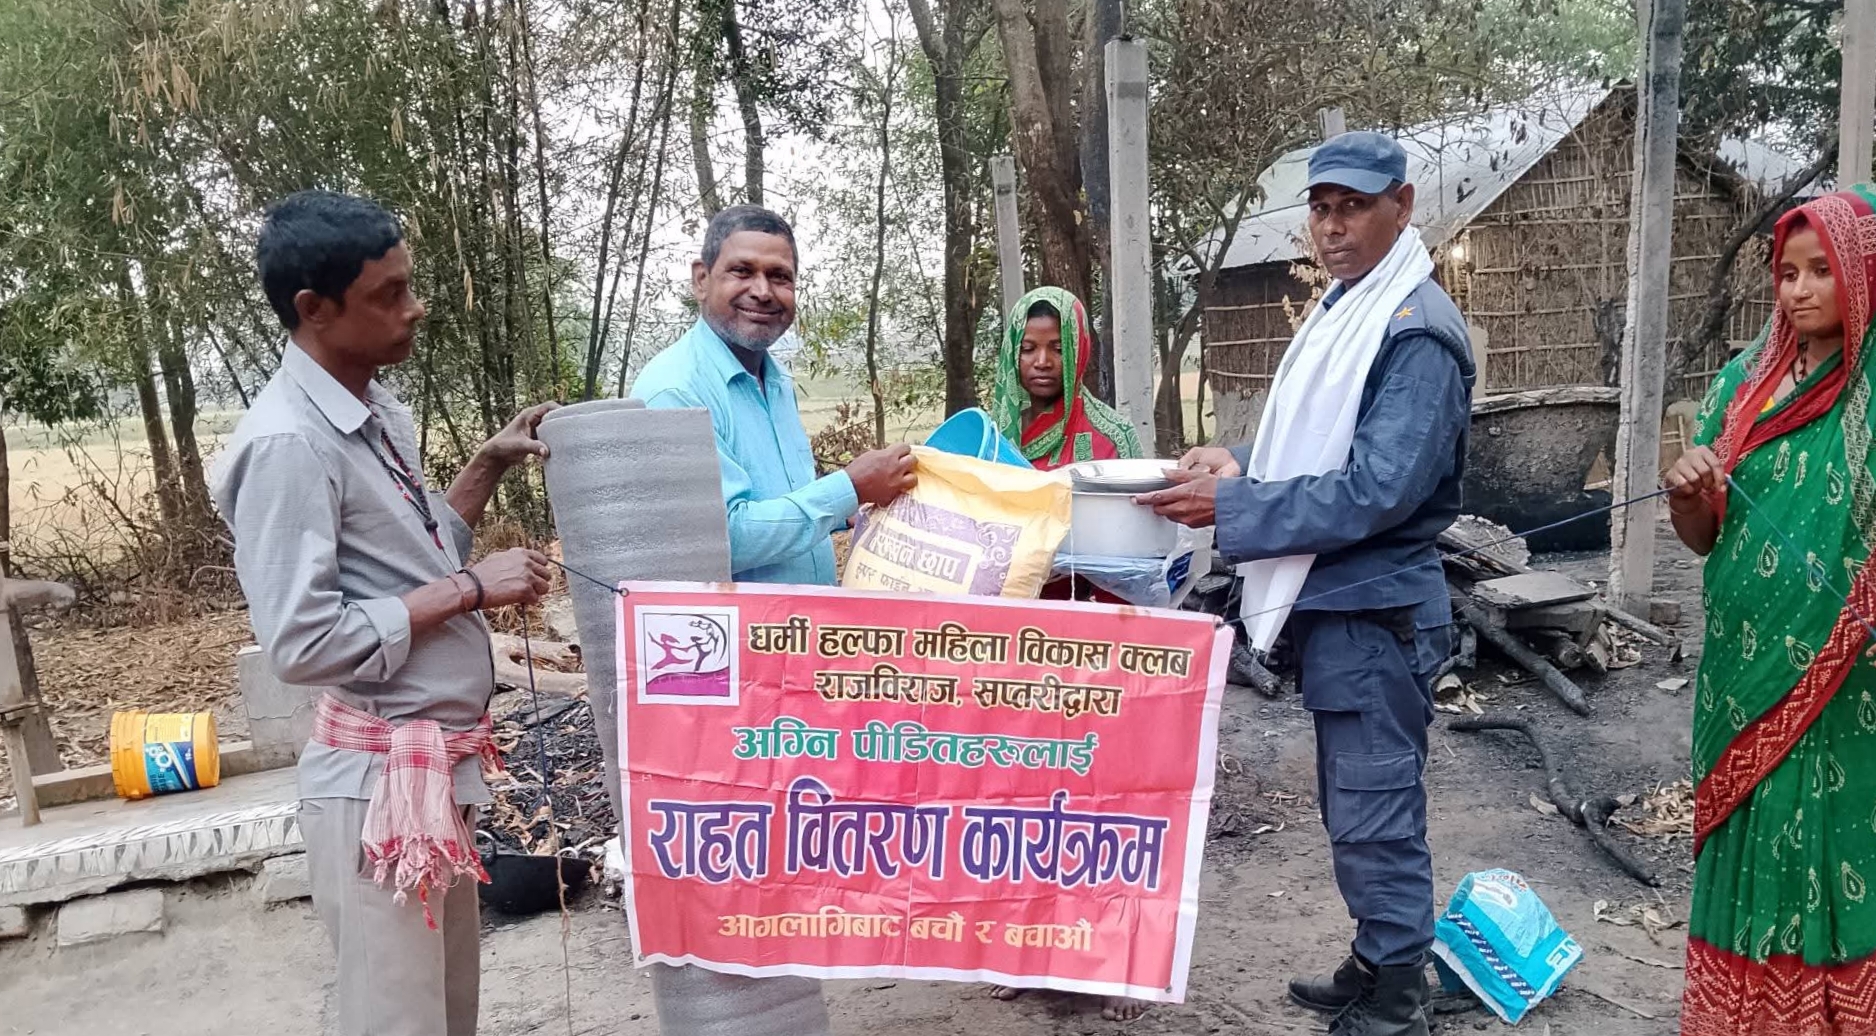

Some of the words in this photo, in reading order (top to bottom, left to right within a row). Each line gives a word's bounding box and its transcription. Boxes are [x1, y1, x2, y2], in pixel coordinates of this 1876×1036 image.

[749, 616, 810, 654] धर्मी
[818, 624, 906, 658] हल्फा
[913, 623, 1010, 663] महिला
[1017, 627, 1112, 670] विकास
[1119, 643, 1192, 677] क्लब
[973, 675, 1123, 717] सप्तरीद्वारा
[733, 717, 841, 760] अग्नि
[851, 721, 1099, 775] पीडितहरूलाई
[649, 800, 773, 882] राहत
[786, 776, 949, 880] वितरण
[961, 790, 1169, 890] कार्यक्रम
[717, 904, 901, 939] आगलागिबाट
[975, 919, 997, 944] र
